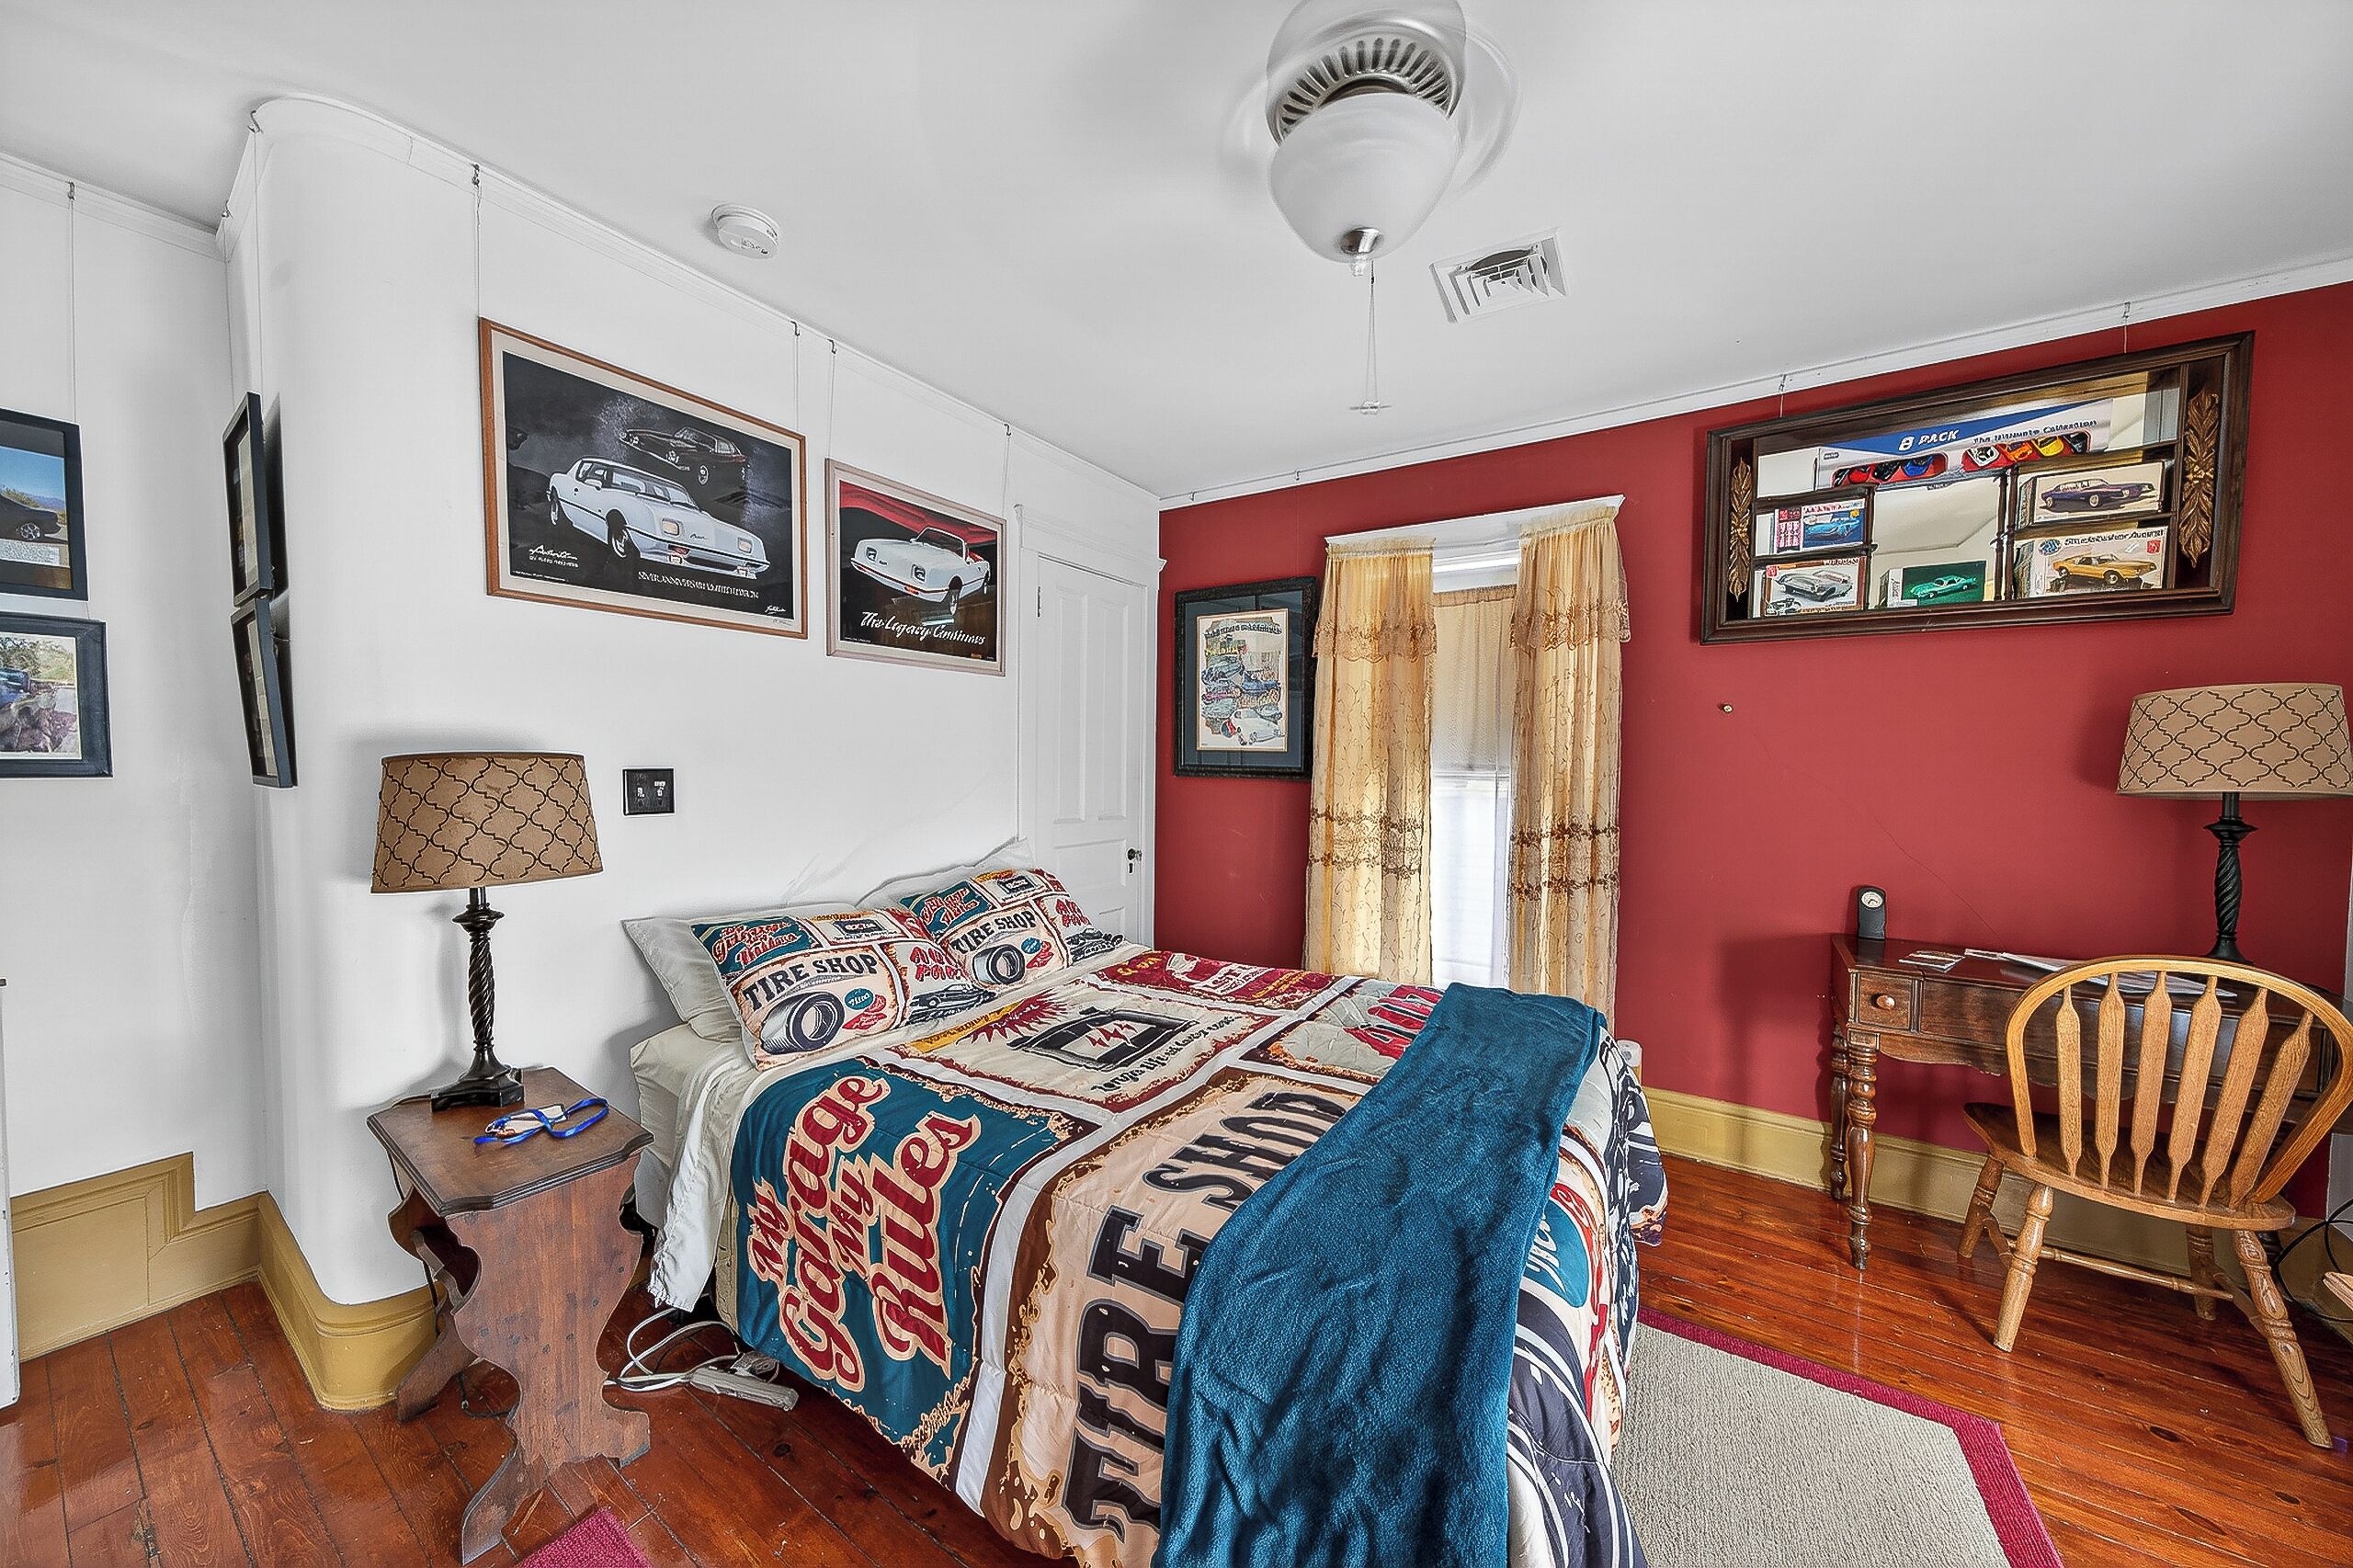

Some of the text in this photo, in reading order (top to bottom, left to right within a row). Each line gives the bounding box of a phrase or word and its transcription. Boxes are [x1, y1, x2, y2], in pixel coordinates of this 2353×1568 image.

[1898, 428, 1960, 451] 8 PACK
[860, 611, 986, 645] The Legacy Continues
[994, 909, 1037, 932] SHOP
[741, 962, 810, 1012] TIRE
[813, 953, 879, 975] SHOP
[747, 1177, 795, 1283] My
[778, 1075, 891, 1392] Garage
[827, 1153, 878, 1277] My
[869, 1112, 983, 1380] Rules
[1062, 1205, 1210, 1542] TIRE
